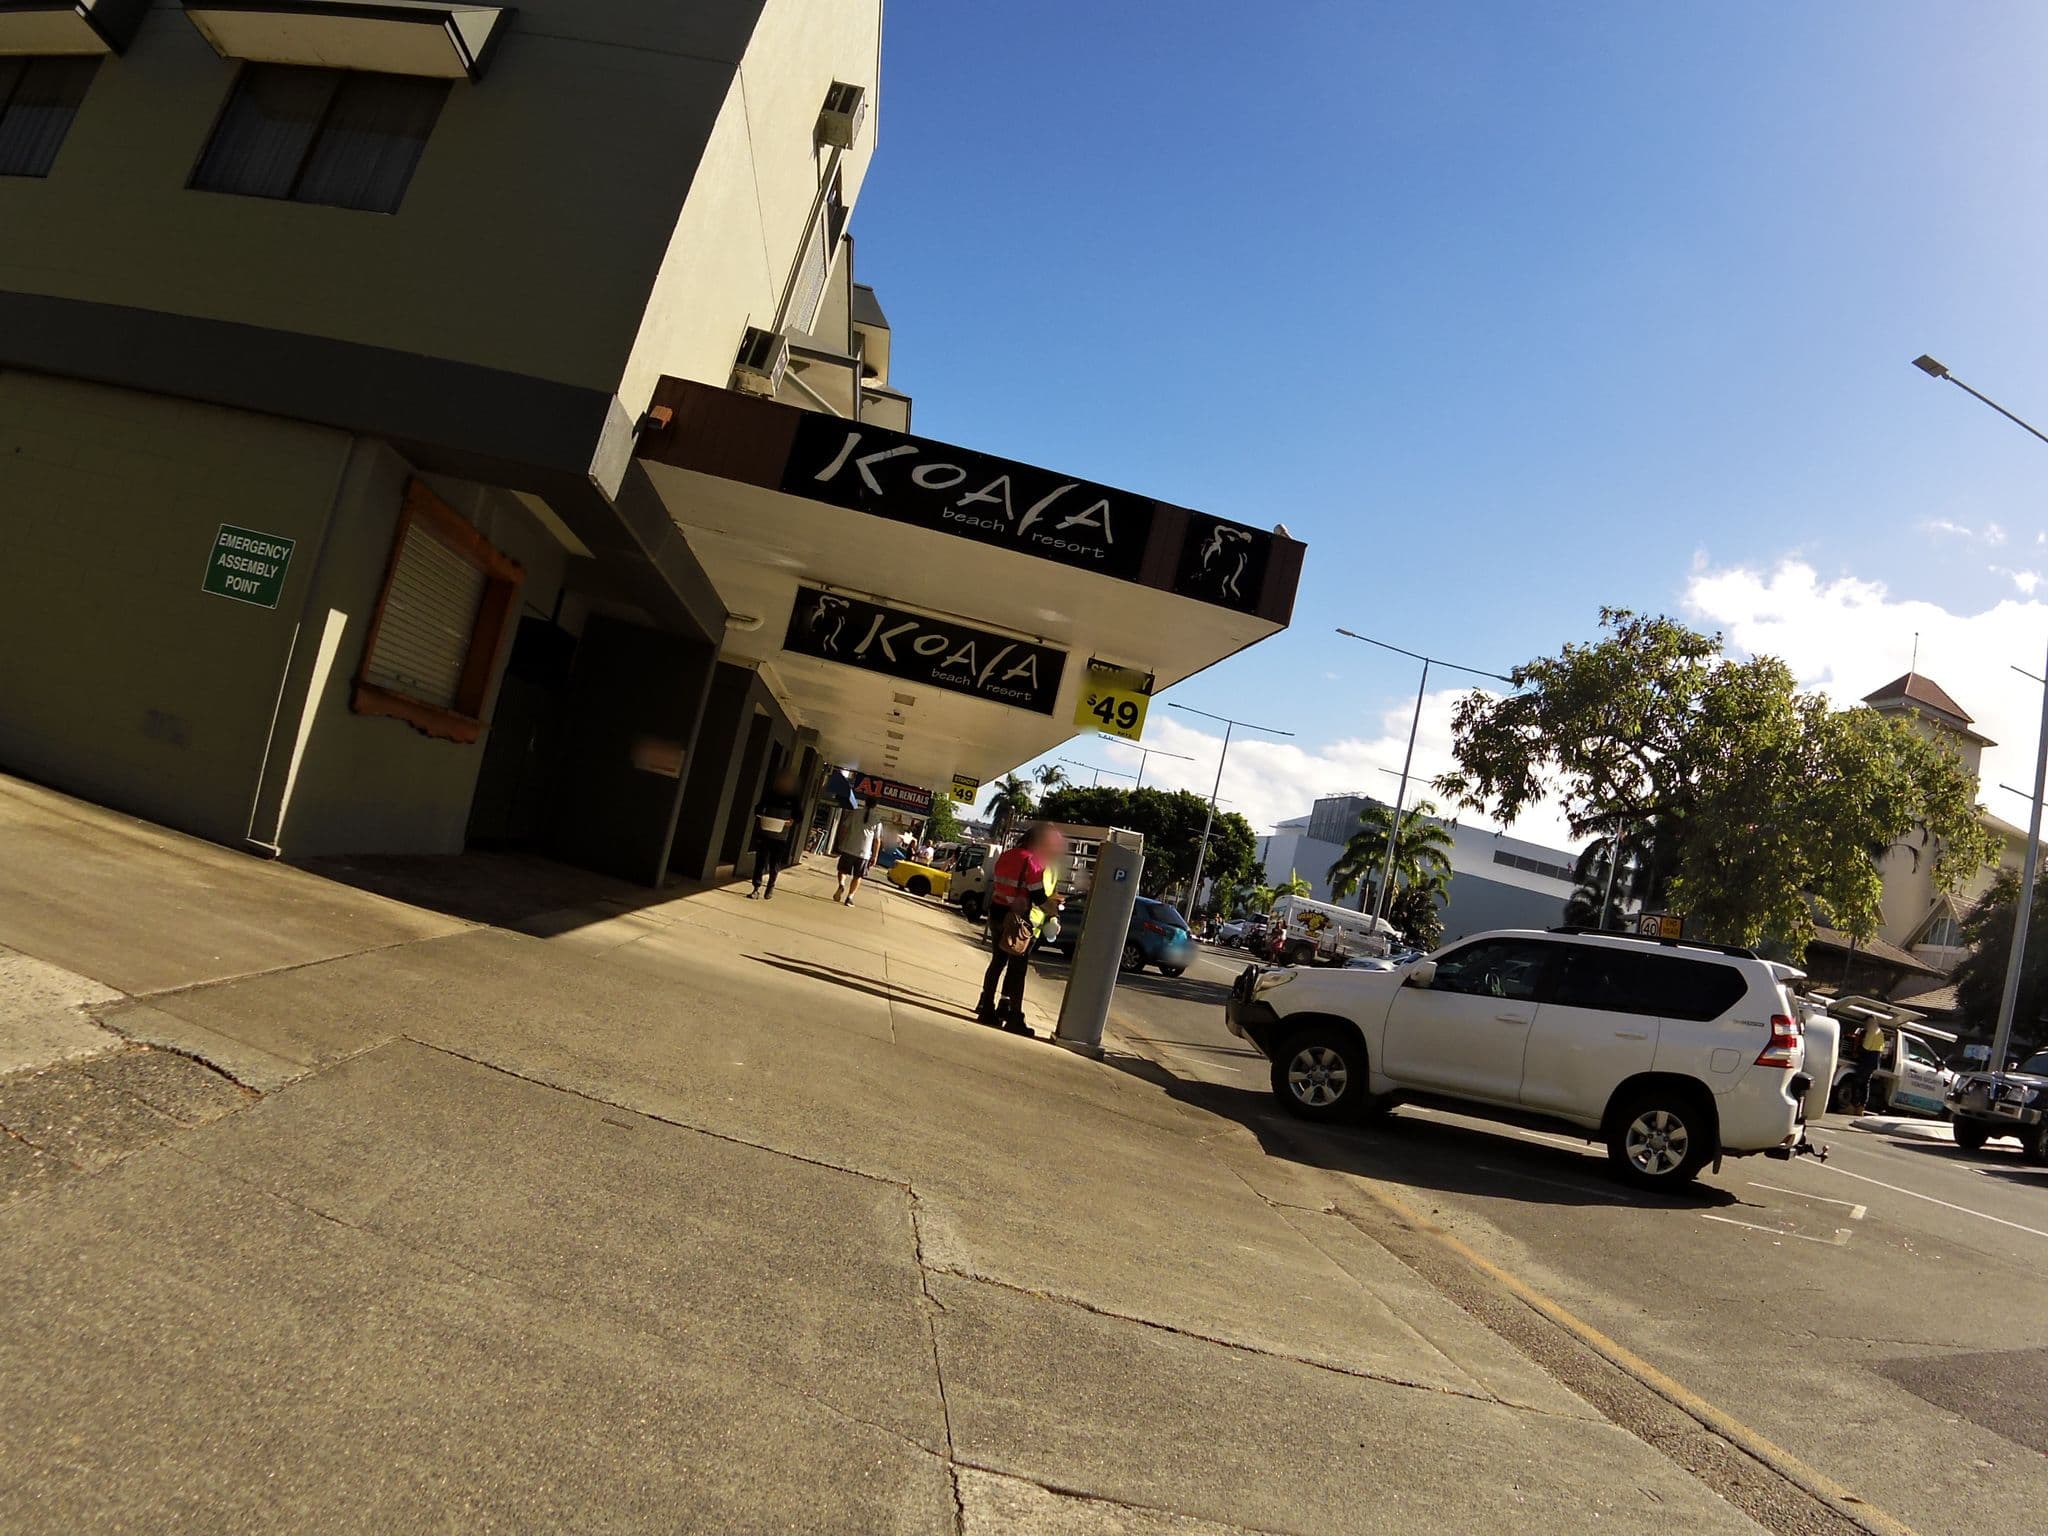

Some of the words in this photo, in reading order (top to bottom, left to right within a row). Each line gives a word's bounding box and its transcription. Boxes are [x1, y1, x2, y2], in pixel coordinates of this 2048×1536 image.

[814, 432, 1114, 544] KOALA
[218, 533, 290, 560] EMERGENCY
[942, 506, 1005, 532] beach
[1032, 531, 1105, 559] resort
[217, 552, 279, 579] ASSEMBLY
[225, 575, 261, 595] POINT
[854, 614, 1038, 689] KOALA
[931, 667, 971, 687] beach
[986, 683, 1032, 702] resort
[1086, 693, 1139, 730] $49
[855, 777, 884, 798] A1
[883, 786, 899, 798] CAR
[899, 788, 930, 805] RENTALS
[1115, 869, 1126, 881] P
[1643, 922, 1657, 936] 40
